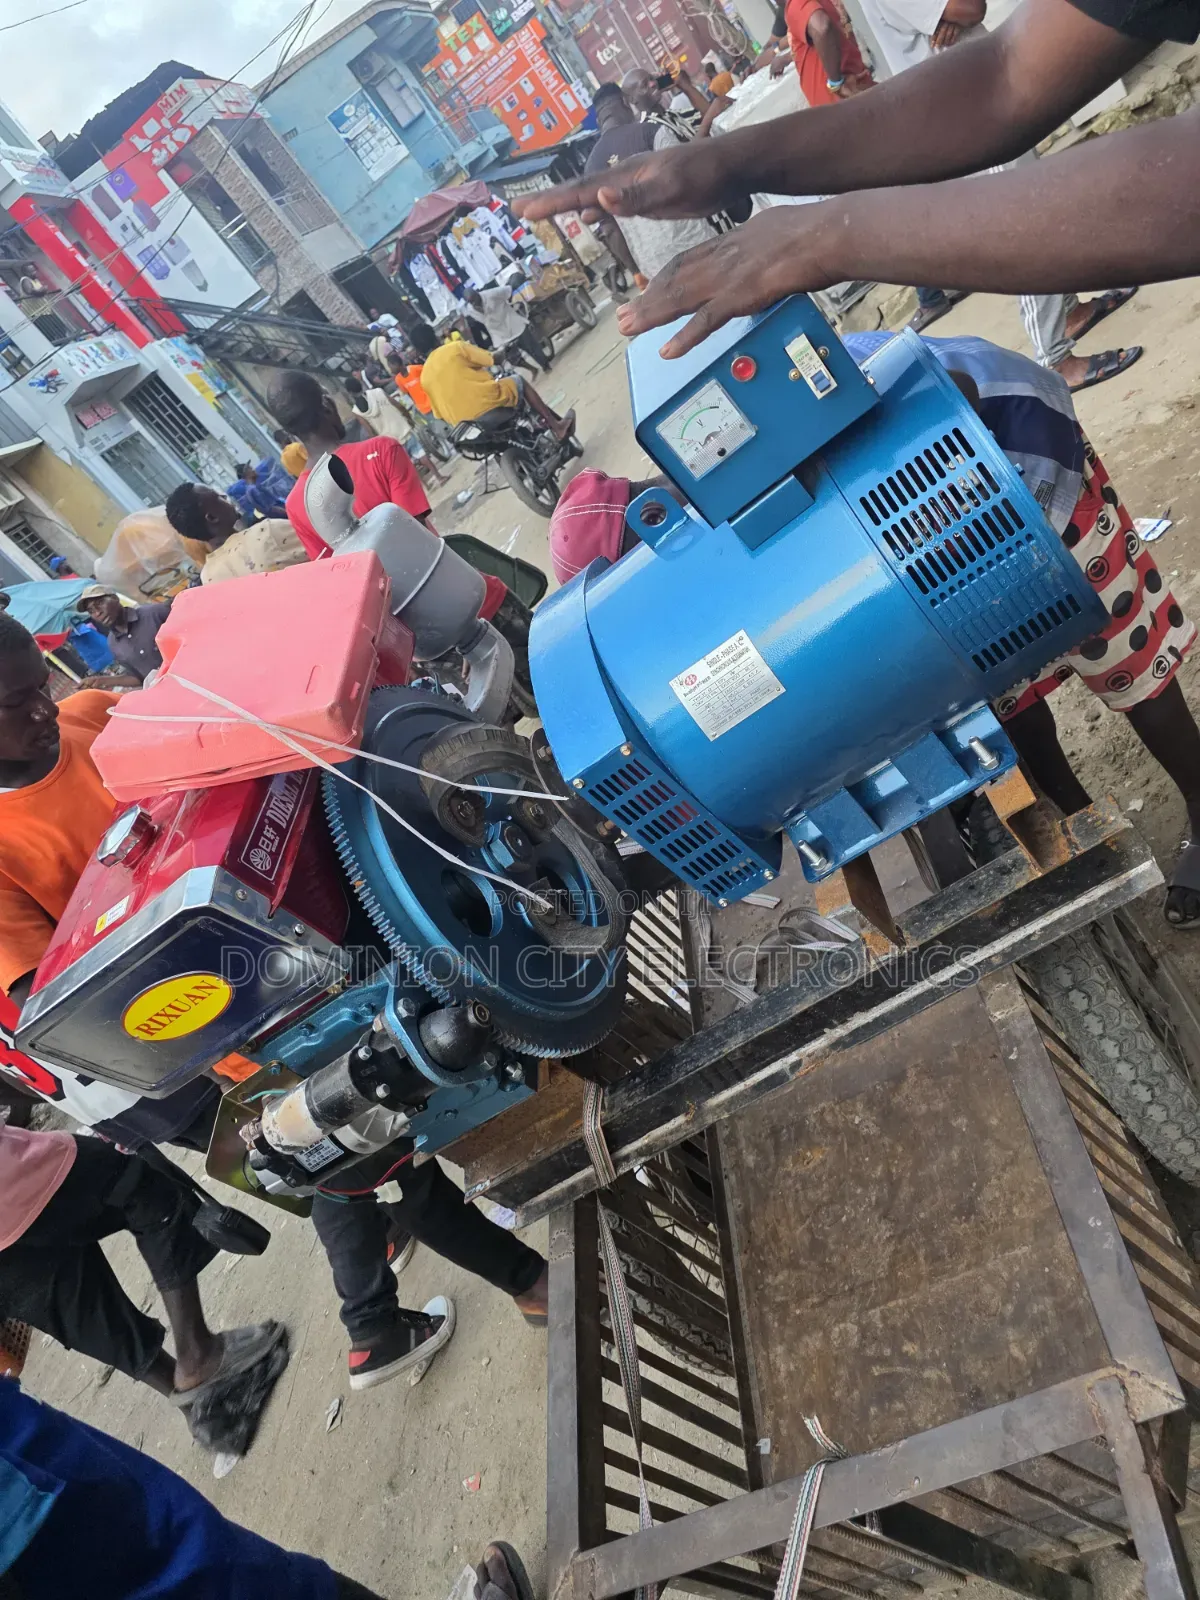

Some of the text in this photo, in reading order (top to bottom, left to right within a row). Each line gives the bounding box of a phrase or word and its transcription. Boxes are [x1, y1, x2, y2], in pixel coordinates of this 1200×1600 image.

[445, 16, 484, 52] TEX
[159, 83, 188, 112] MIM
[266, 783, 300, 828] DIESEL
[134, 979, 220, 1036] RIXUAN
